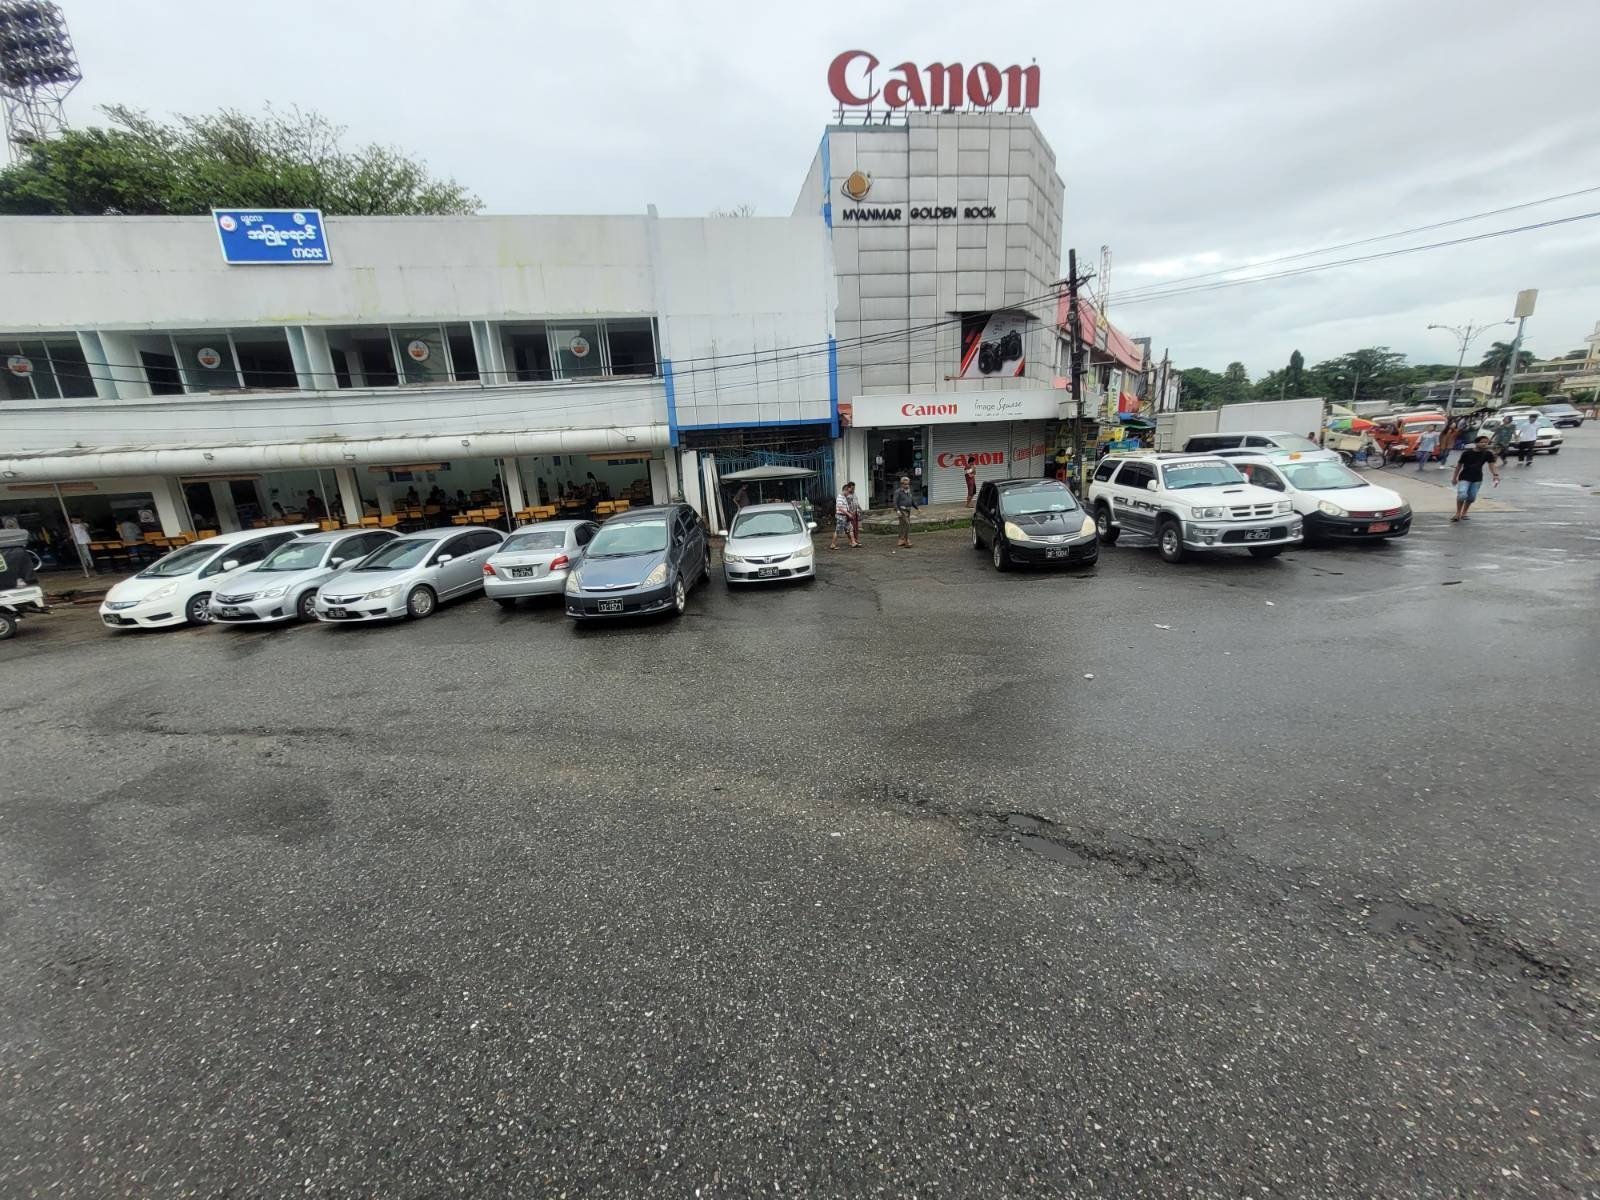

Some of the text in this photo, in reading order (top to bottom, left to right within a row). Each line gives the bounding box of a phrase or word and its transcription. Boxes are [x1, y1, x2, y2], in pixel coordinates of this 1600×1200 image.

[827, 49, 1041, 108] Canon
[842, 206, 996, 221] MYANMAR GOLDEN ROCK
[901, 403, 958, 417] Canon
[1113, 496, 1162, 513] SURF
